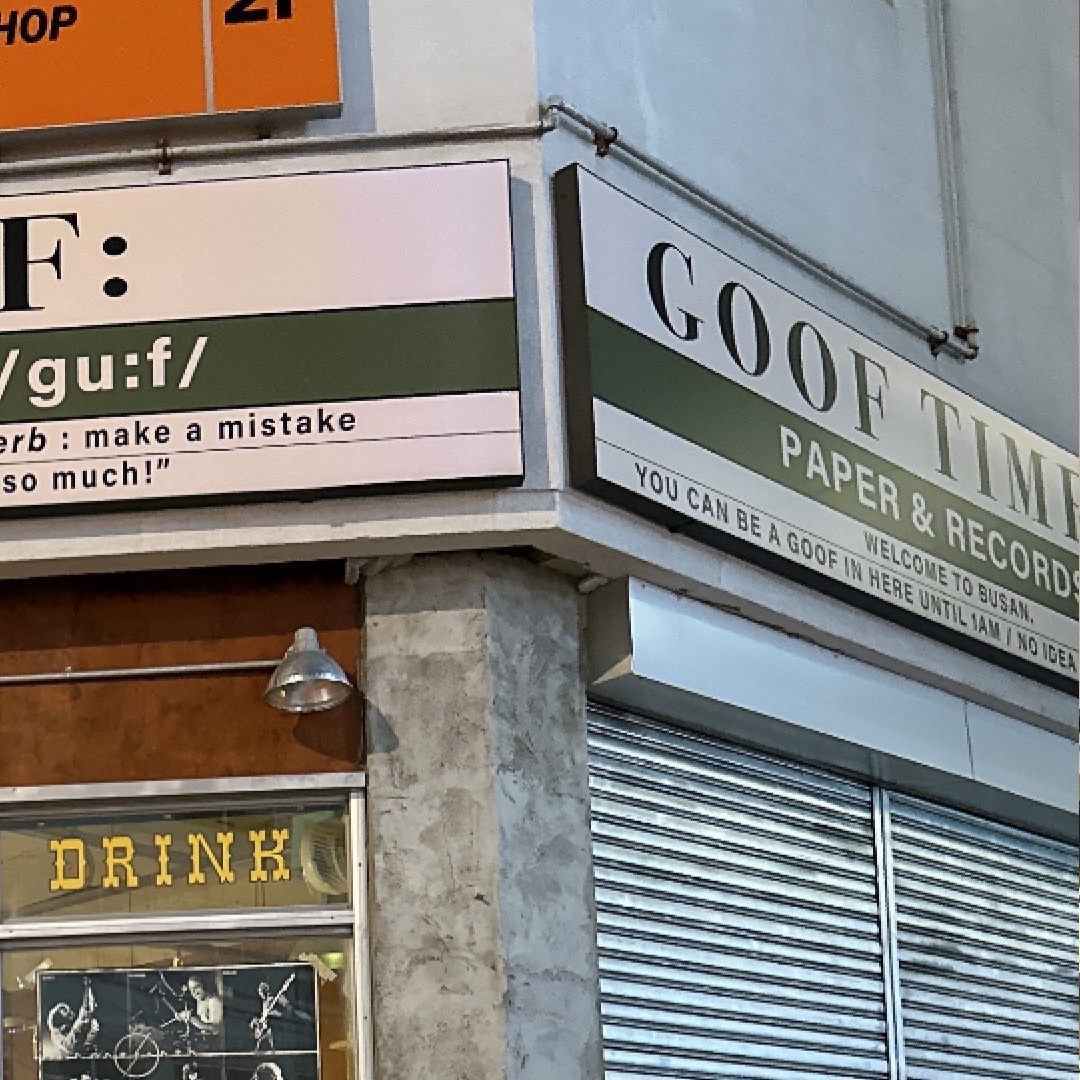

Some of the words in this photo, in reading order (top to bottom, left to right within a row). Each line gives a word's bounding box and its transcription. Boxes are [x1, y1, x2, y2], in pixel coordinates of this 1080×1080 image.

[646, 242, 890, 441] GOOF
[84, 420, 171, 449] make
[186, 422, 202, 442] a
[217, 408, 357, 440] mistake
[2, 472, 38, 493] so
[779, 424, 901, 520] PAPER
[912, 492, 936, 538] &
[945, 507, 1079, 604] RECORD
[634, 462, 678, 501] YOU
[686, 486, 729, 524] CAN
[736, 508, 762, 538] BE
[769, 522, 782, 548] A
[786, 530, 838, 570] GOOF
[844, 556, 863, 582] IN
[869, 565, 914, 605] HERE
[919, 588, 968, 627] UNTIL
[971, 611, 1001, 641] 1AM
[1018, 630, 1038, 656] NO
[863, 529, 948, 586] WELCOME
[953, 571, 974, 597] TO
[978, 582, 1034, 624] BUSAN.
[49, 828, 290, 890] DRINK
